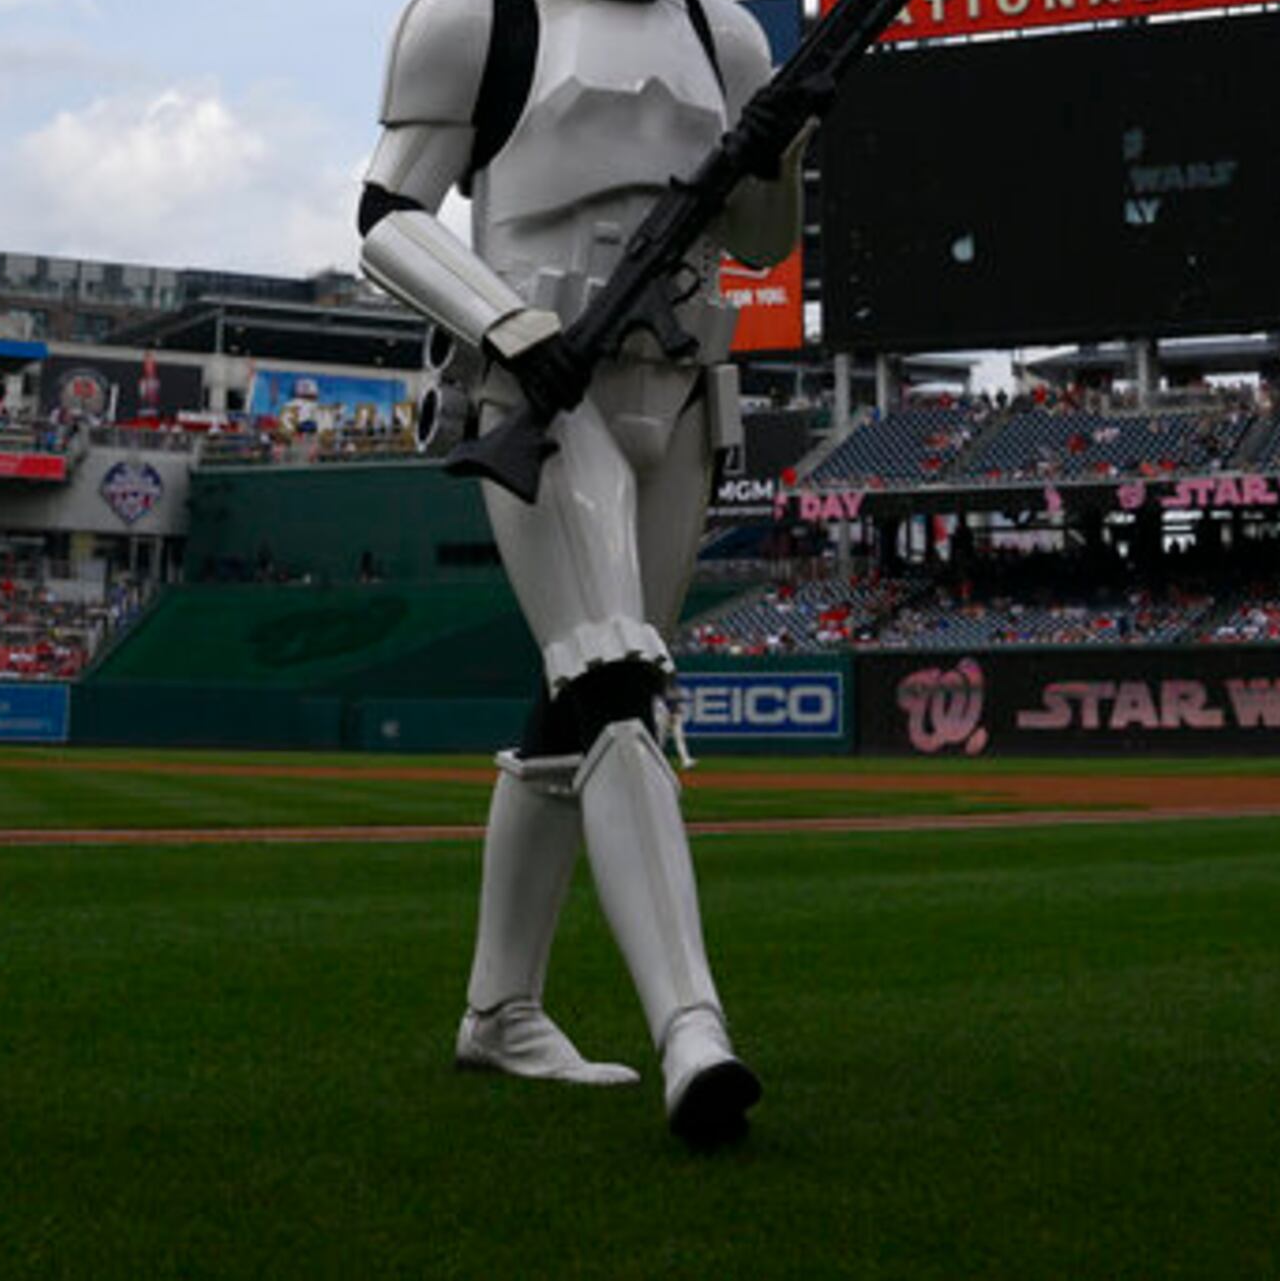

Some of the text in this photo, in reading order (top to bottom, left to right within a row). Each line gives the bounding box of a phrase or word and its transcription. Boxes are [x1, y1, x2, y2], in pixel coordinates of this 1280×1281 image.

[798, 492, 866, 521] DAY
[1160, 476, 1279, 509] STAR
[1016, 678, 1226, 730] STAR
